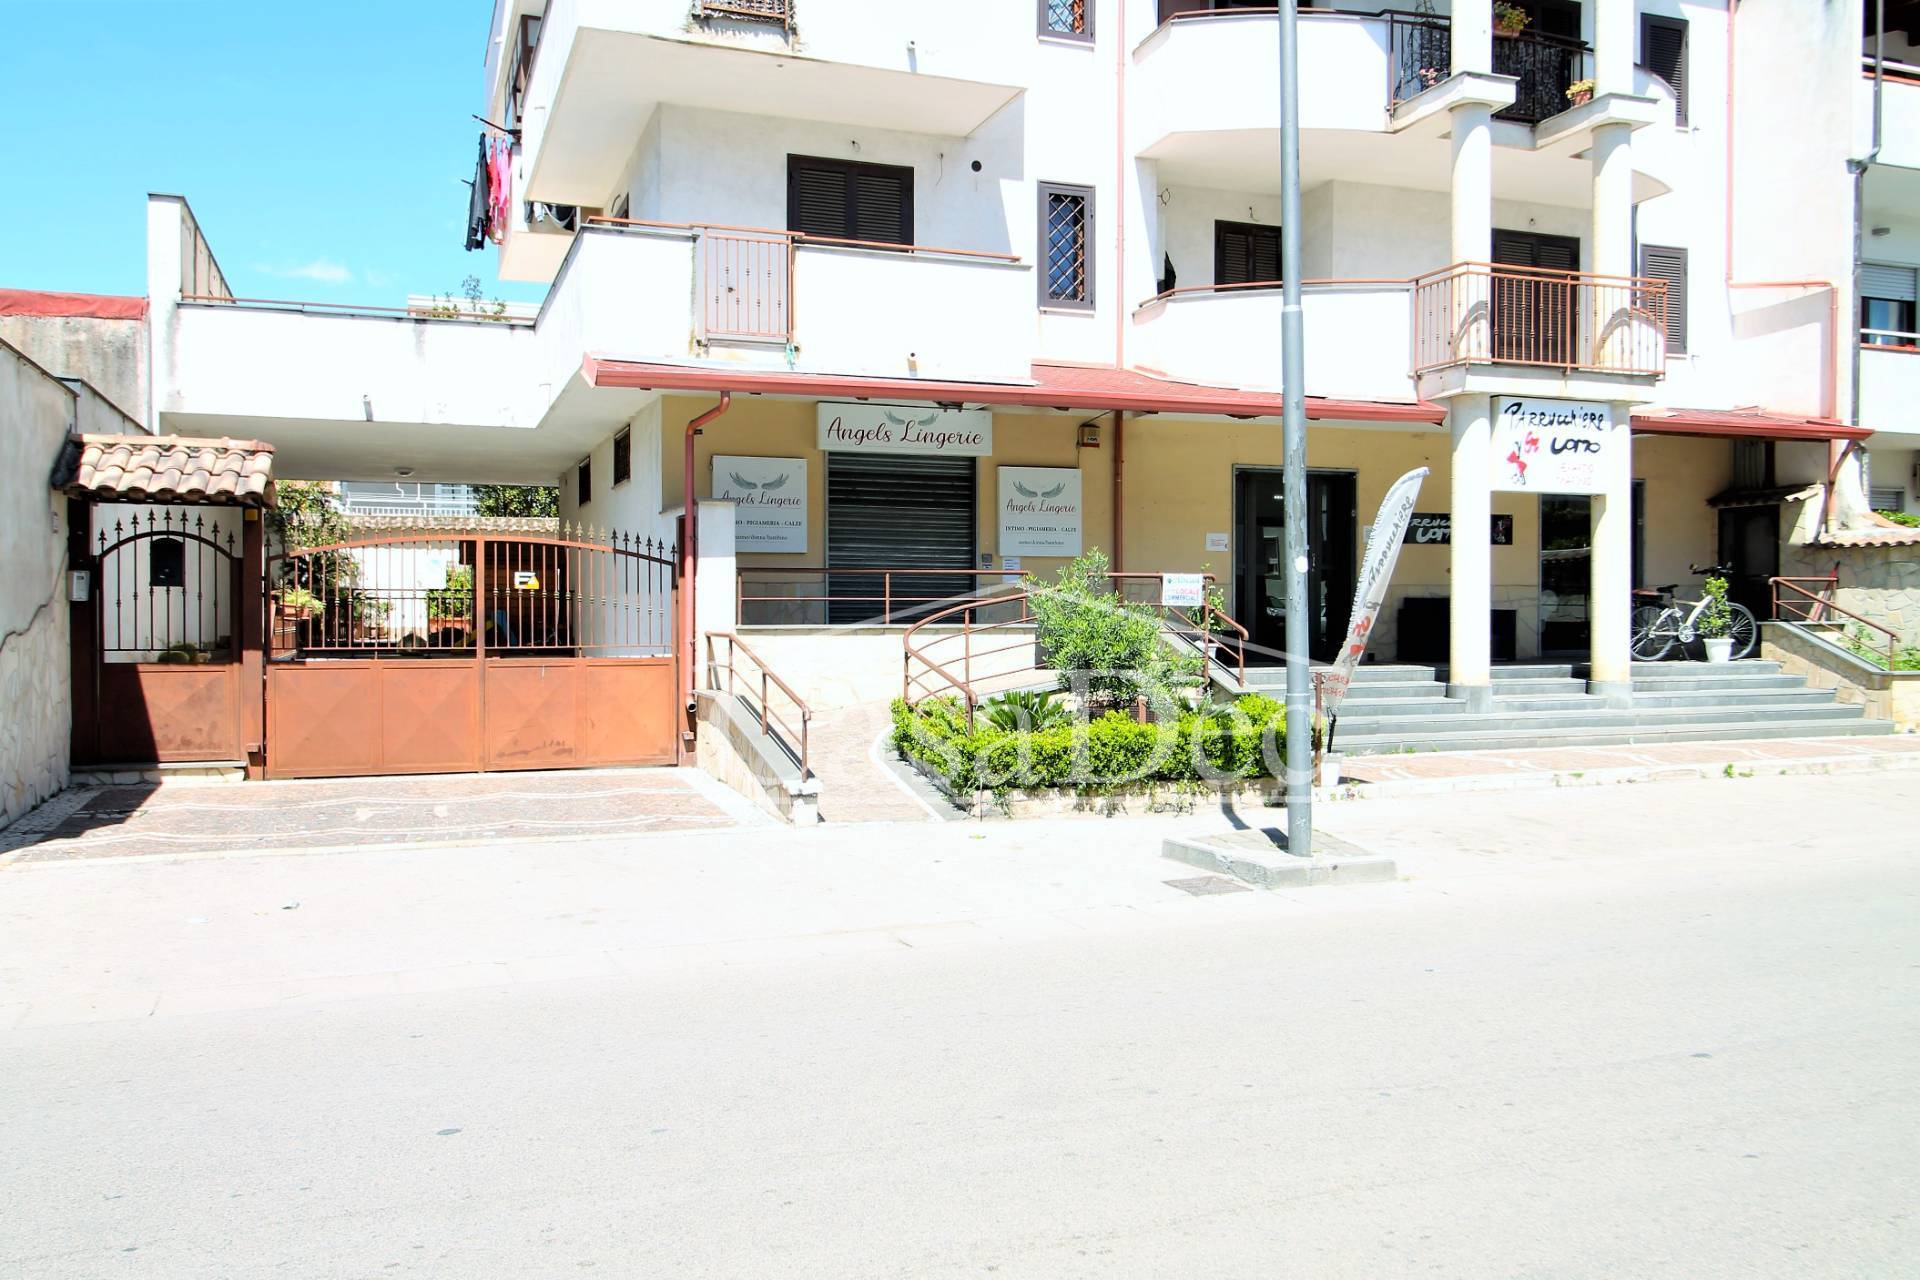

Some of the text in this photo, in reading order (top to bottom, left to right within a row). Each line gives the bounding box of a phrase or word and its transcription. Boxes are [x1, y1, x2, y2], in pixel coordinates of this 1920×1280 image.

[827, 416, 984, 449] Angels Lingerie
[758, 490, 801, 507] Lingerie
[1006, 497, 1076, 515] Angels Lingerie
